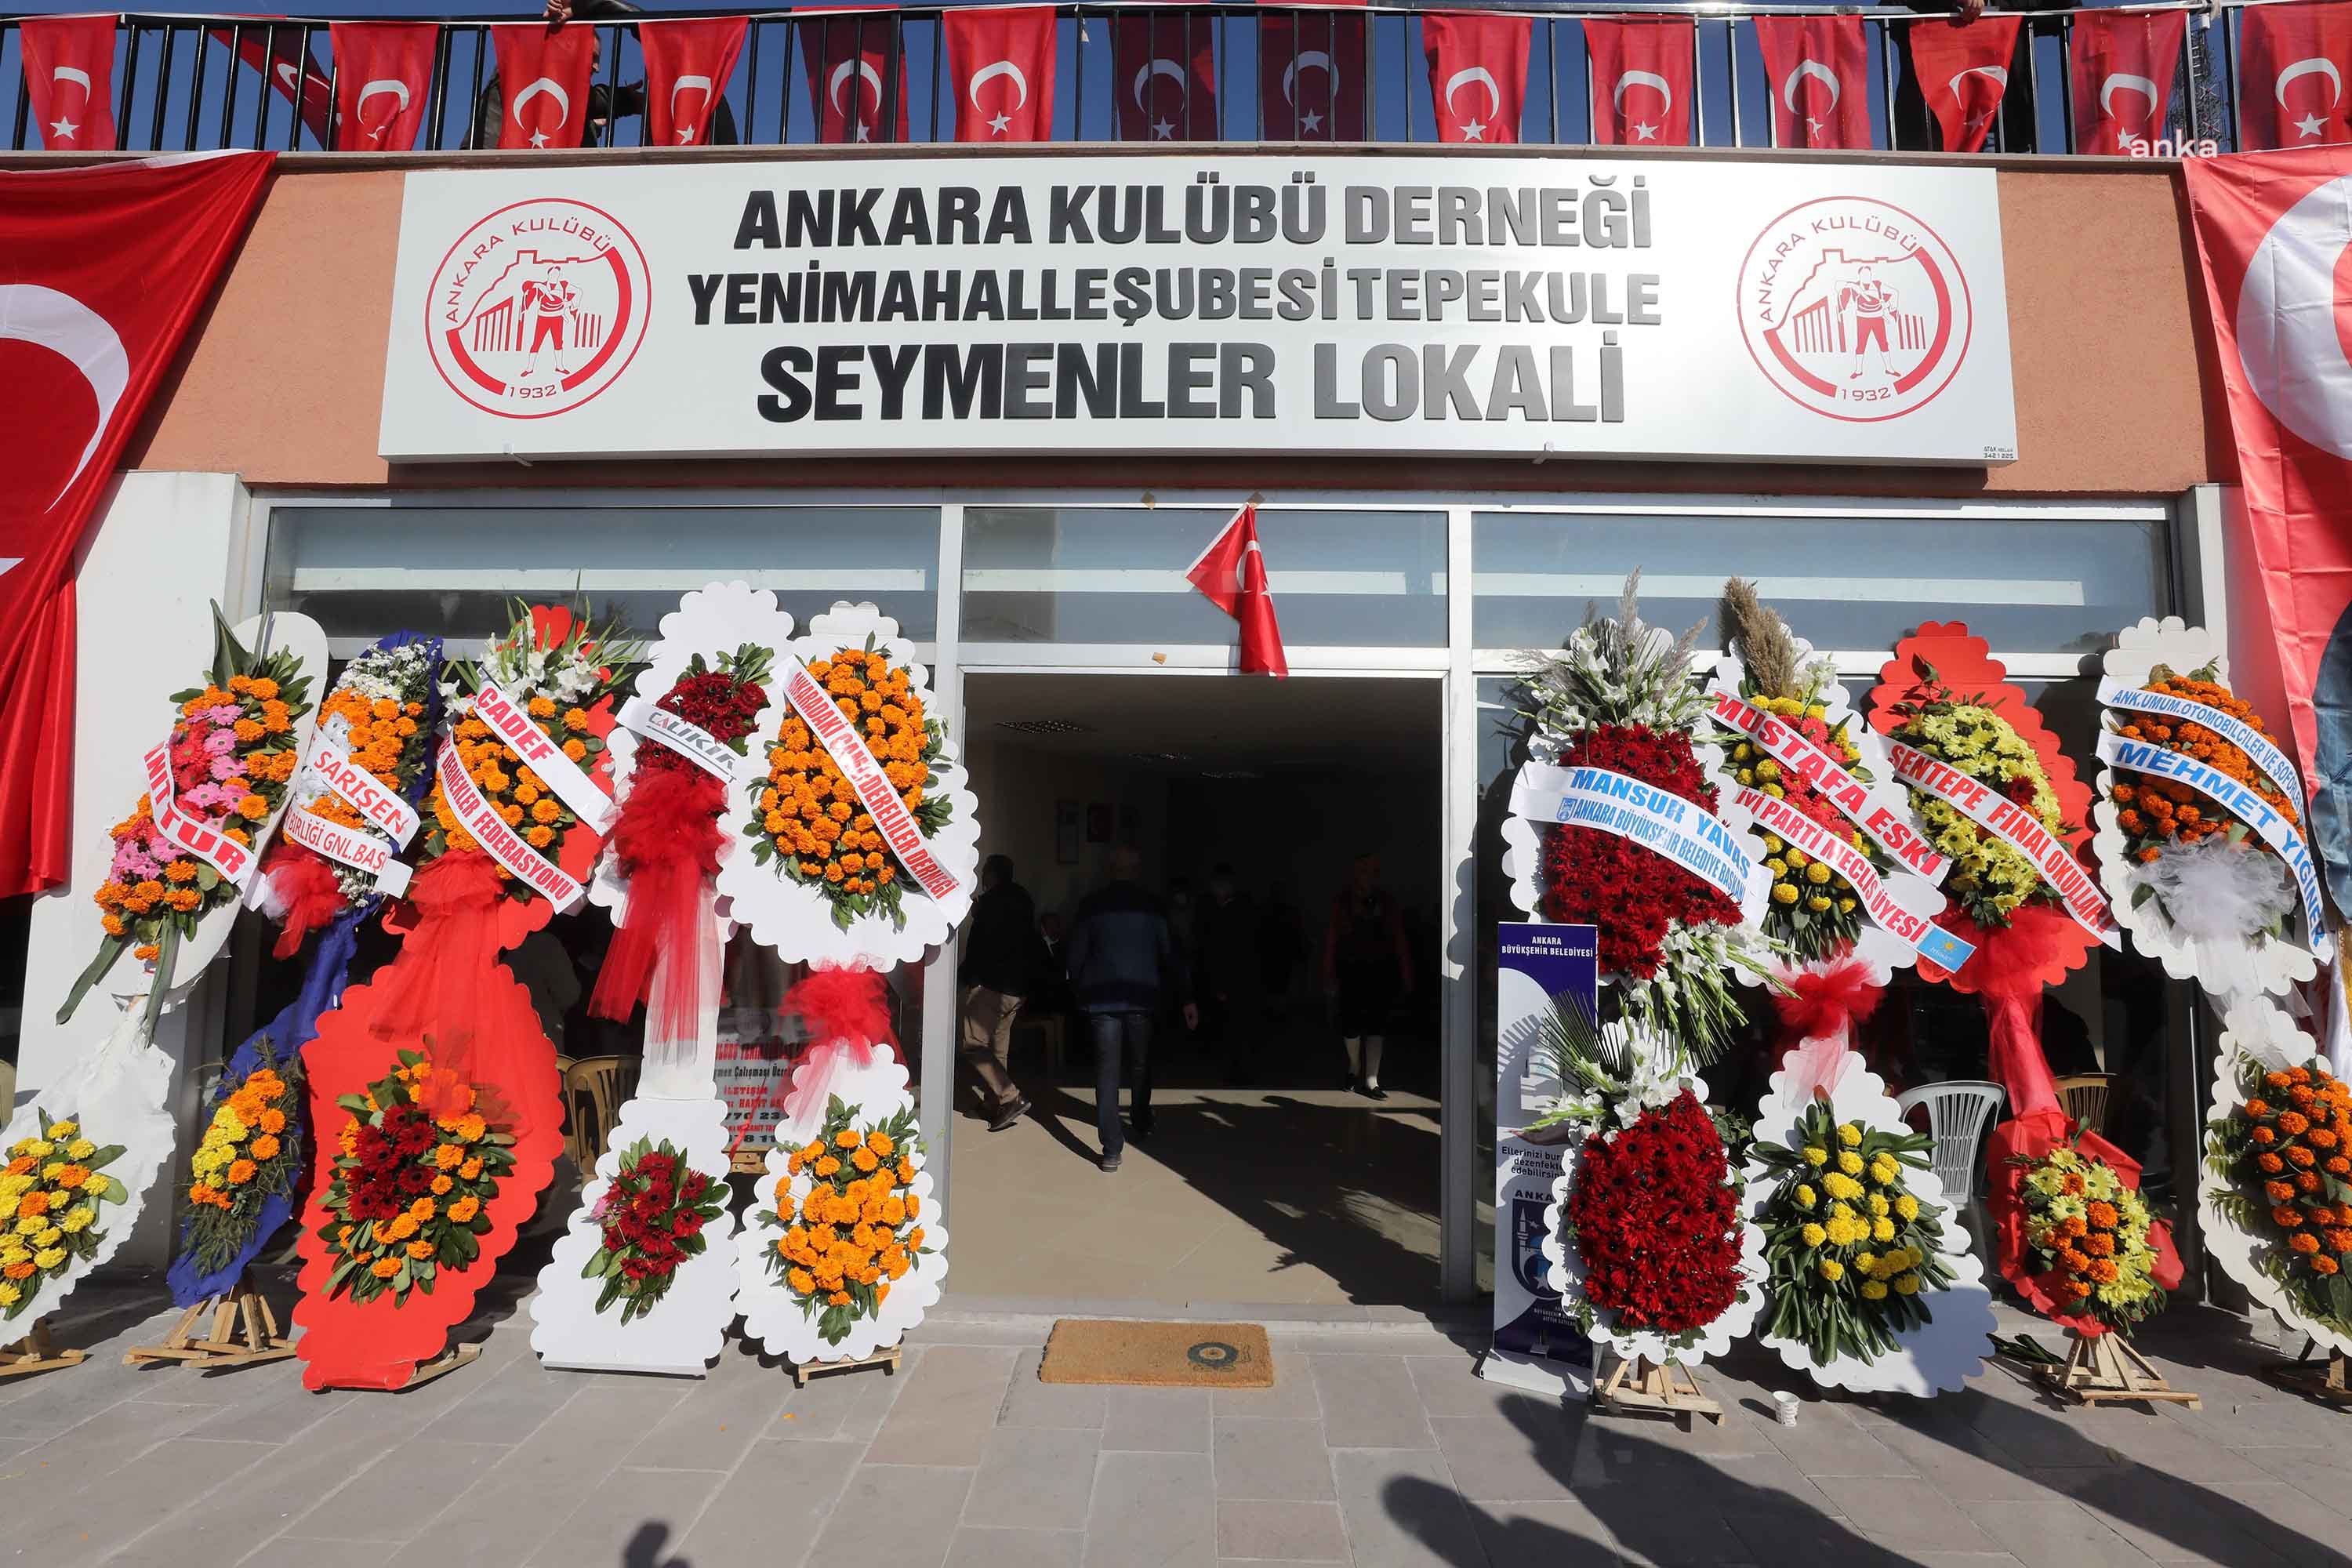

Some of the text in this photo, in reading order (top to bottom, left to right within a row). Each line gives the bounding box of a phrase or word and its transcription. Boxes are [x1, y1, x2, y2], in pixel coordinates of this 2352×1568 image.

[734, 171, 1651, 249] ANKARA KULÜBÜ DERNEĞİ
[446, 216, 612, 323] ANKARA KULÜBÜ
[1347, 268, 1661, 325] TEPEKULE
[1759, 216, 1918, 323] ANKARA KULÜBÜ
[510, 385, 557, 399] 1932
[757, 331, 1624, 423] SEYMENLER LOKALİ
[1842, 387, 1891, 401] 1932
[1710, 691, 1868, 815] MUSTAFA
[2115, 742, 2278, 829] MEHMET
[2262, 747, 2279, 771] VE
[314, 751, 409, 835] SARIŞEN
[1570, 769, 1686, 824] MANSUR
[160, 802, 246, 875] TUR
[472, 810, 574, 901] FEDERASYONU
[1573, 798, 1617, 826] ANKARA
[1678, 837, 1721, 879] BELEDİYE
[1759, 800, 1827, 851] PARTİ
[1820, 838, 1878, 901] MECLİS
[1870, 889, 1930, 943] ÜYESİ
[1501, 944, 1593, 957] BÜYÜKŞEHİR BELEDİYESİ
[1532, 936, 1562, 945] ANKARA
[1501, 1146, 1563, 1161] Ellerinizi bur
[1515, 1190, 1556, 1203] ANKA
